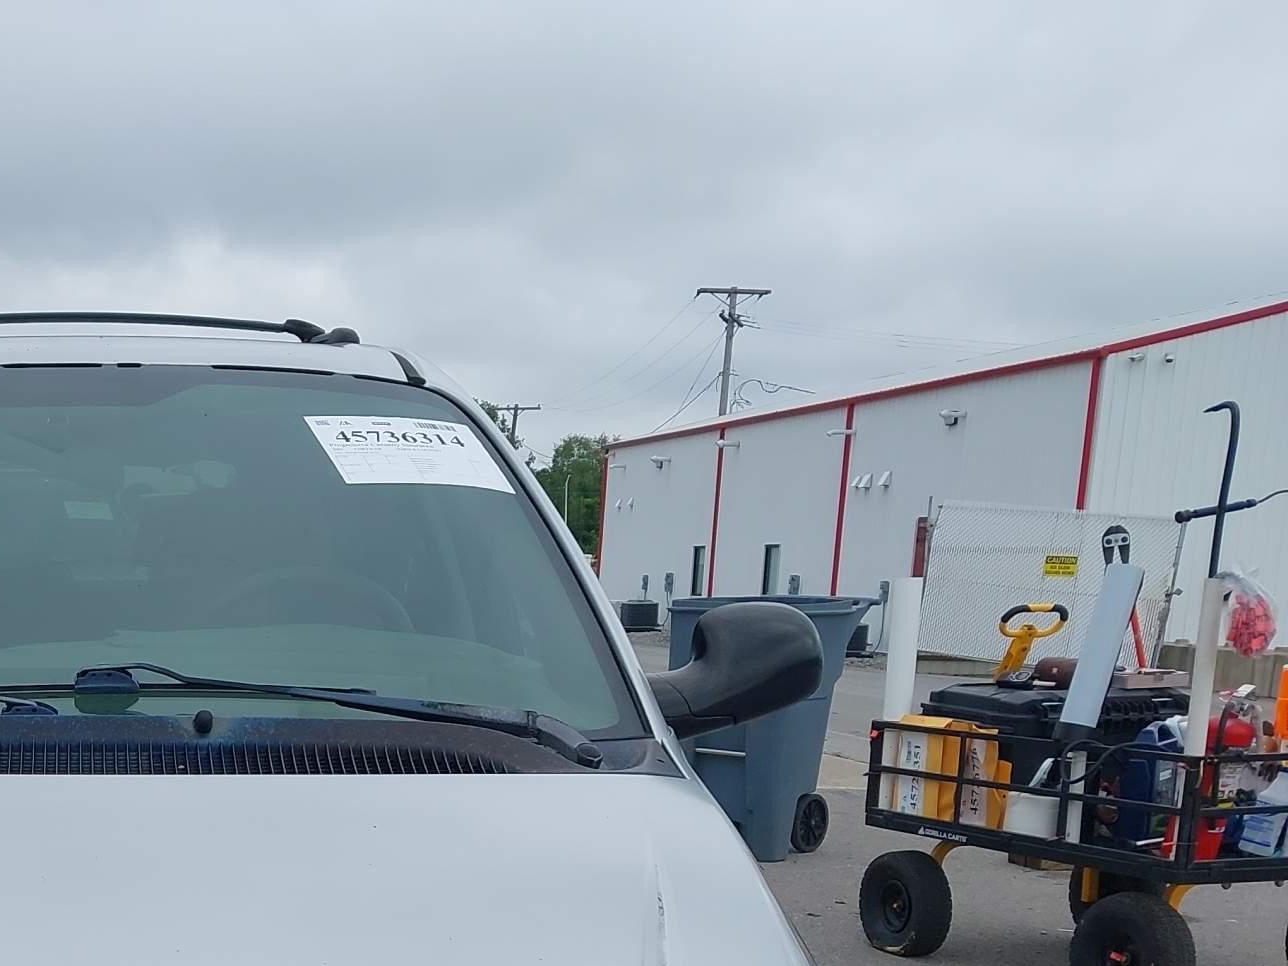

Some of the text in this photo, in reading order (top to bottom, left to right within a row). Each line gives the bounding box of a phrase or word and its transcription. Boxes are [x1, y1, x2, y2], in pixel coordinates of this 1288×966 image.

[335, 430, 465, 448] 45736314
[1047, 556, 1077, 564] CAUTION
[909, 745, 921, 810] 4572351
